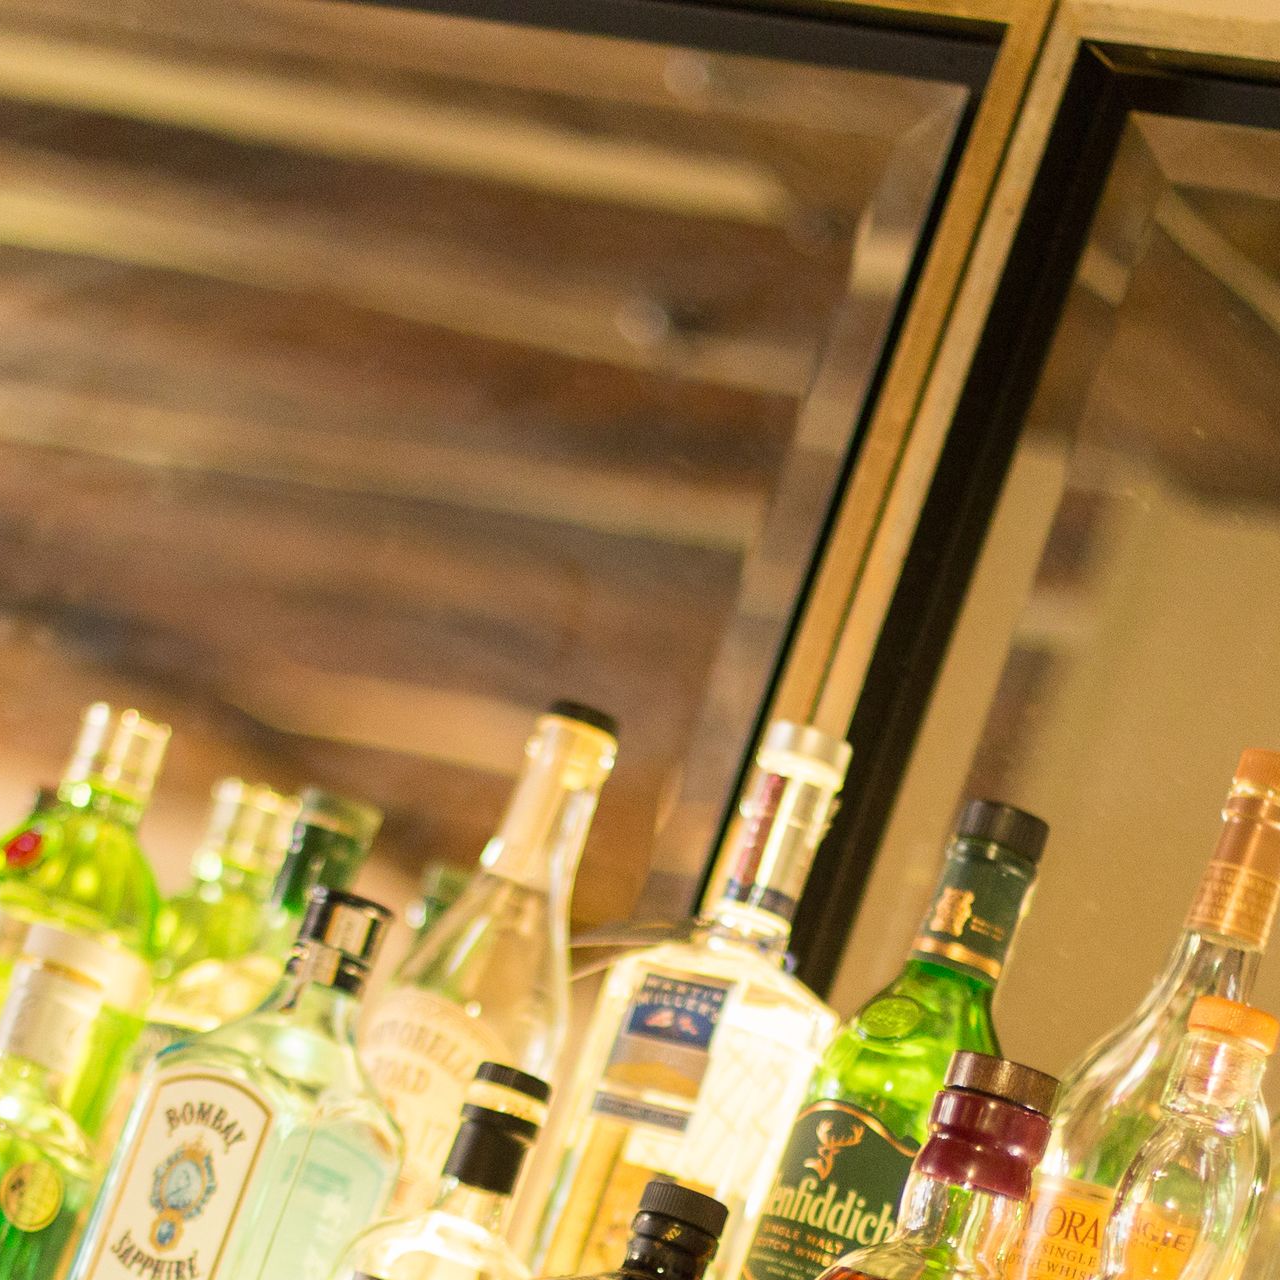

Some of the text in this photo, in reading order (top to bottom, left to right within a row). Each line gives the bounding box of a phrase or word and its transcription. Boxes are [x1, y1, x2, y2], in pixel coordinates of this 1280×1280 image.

[166, 1102, 247, 1154] BOMBAY
[766, 1176, 898, 1247] enfiddich
[795, 1244, 837, 1268] WHIS
